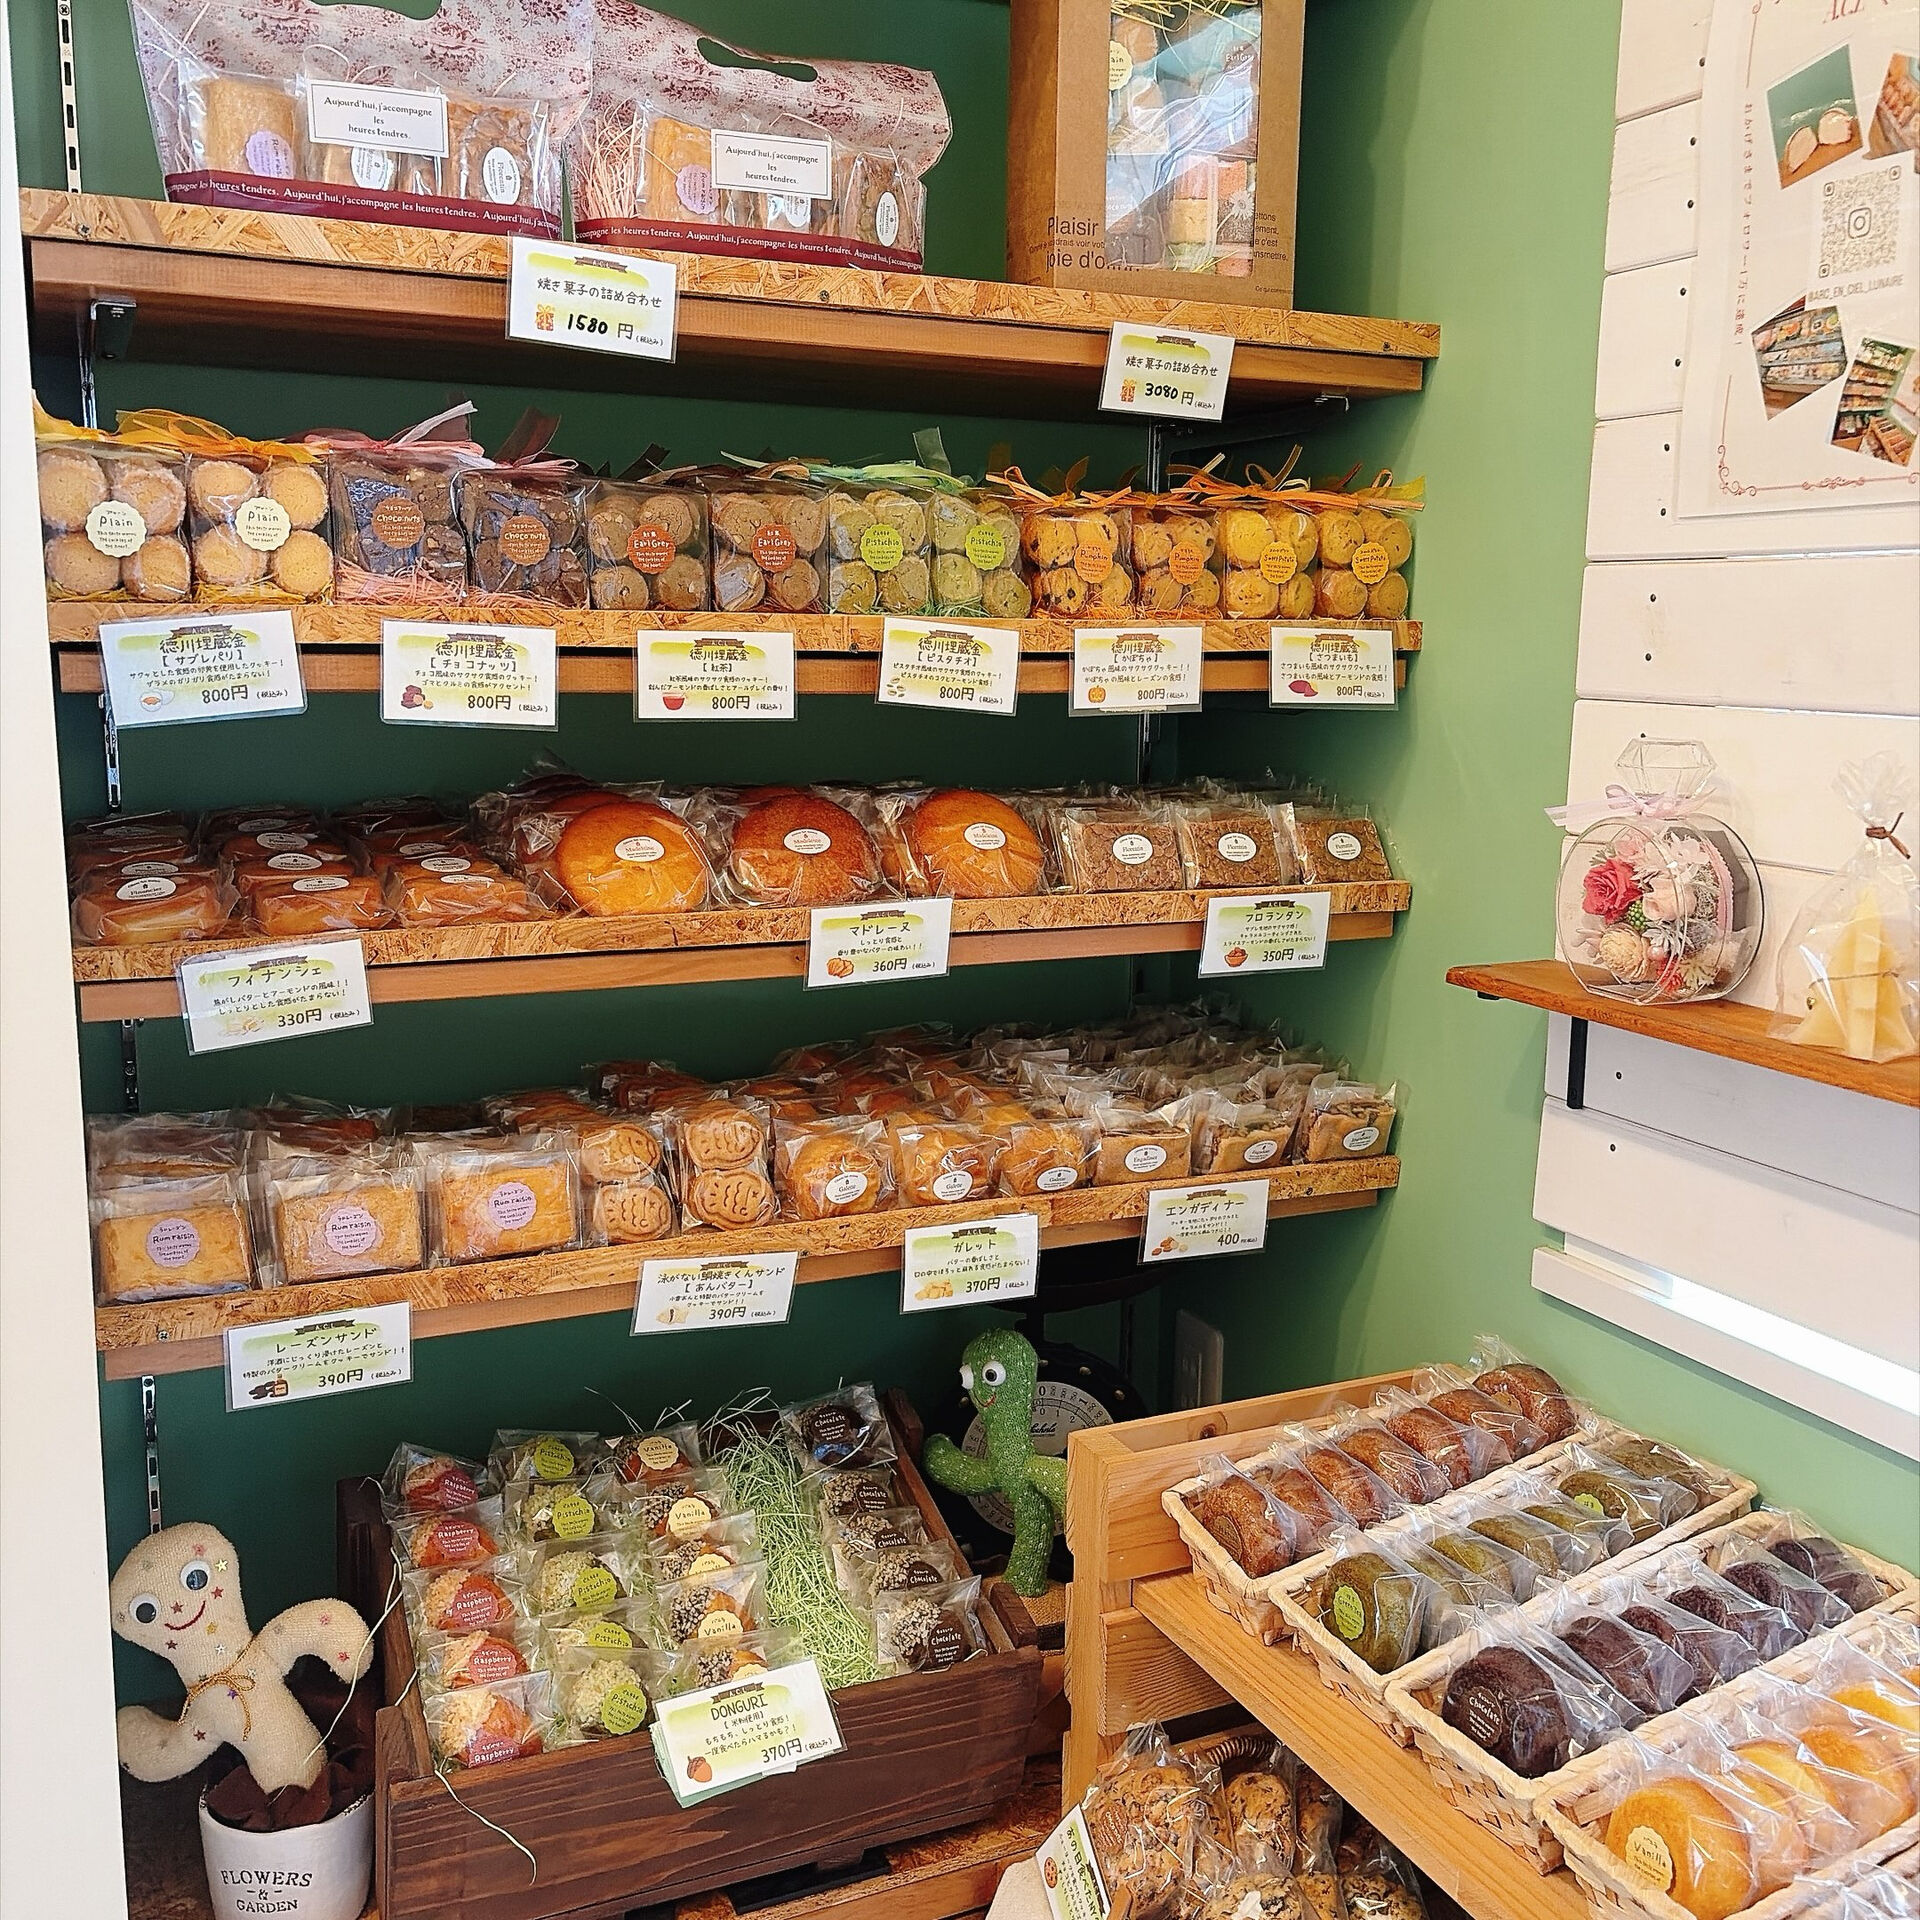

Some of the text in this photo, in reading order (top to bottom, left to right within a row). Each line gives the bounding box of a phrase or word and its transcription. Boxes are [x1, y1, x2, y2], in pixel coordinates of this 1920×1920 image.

[373, 116, 385, 125] les
[348, 124, 376, 135] heures
[767, 163, 778, 172] les
[745, 172, 769, 182] heures
[209, 179, 240, 192] heures
[402, 201, 414, 211] les
[415, 203, 444, 215] heures
[1048, 216, 1099, 237] Plaisir
[611, 227, 621, 235] les
[623, 227, 650, 238] heures
[788, 240, 799, 250] les
[799, 242, 826, 253] heures
[537, 277, 662, 308] 焼き菓子の詰め合わせ
[1125, 355, 1218, 377] 焼き菓子の詰め合わせ
[100, 515, 133, 527] Plain
[248, 510, 279, 521] Plain
[865, 538, 899, 547] Pistachio
[970, 536, 1001, 547] Pistachio
[1080, 549, 1109, 560] Pumpkin
[1174, 553, 1200, 563] Pumpkin
[160, 633, 247, 653] 徳川埋蔵金
[918, 637, 984, 657] 徳川埋蔵金
[1111, 642, 1165, 654] 徳川埋蔵金
[1310, 641, 1360, 654] 徳川埋蔵金
[436, 642, 518, 659] 徳川埋蔵金
[690, 648, 750, 662] 徳川埋蔵金
[202, 685, 248, 704] 800円
[939, 686, 975, 701] 800円
[1137, 688, 1165, 700] 800円
[1336, 685, 1363, 697] 800円
[468, 695, 511, 710] 800円
[711, 695, 750, 710] 800円
[1246, 911, 1304, 922] フロランタン
[850, 921, 911, 937] マドレーヌ
[1262, 948, 1294, 963] 350円
[873, 958, 907, 972] 360円
[228, 965, 322, 988] フィナンシェ
[278, 1008, 322, 1028] 330円
[1166, 1200, 1244, 1216] エンガディナー
[954, 1239, 996, 1253] ガレット
[658, 1267, 785, 1285] 泳がない鯛焼きくんサンド
[966, 1277, 1000, 1293] 370円
[709, 1306, 746, 1320] 390円
[276, 1328, 377, 1353] レーズンサンド
[318, 1369, 363, 1388] 390円
[814, 1415, 846, 1428] Chocolate
[540, 1448, 572, 1463] Pistachio
[643, 1444, 673, 1453] Vanilla
[444, 1479, 476, 1495] Raspberry
[859, 1490, 887, 1499] Chocolate
[557, 1508, 590, 1518] Pistachio
[675, 1509, 705, 1520] Vanilla
[438, 1527, 474, 1539] Raspberry
[877, 1537, 907, 1548] Chocolate
[578, 1577, 612, 1596] Pistachio
[909, 1575, 938, 1584] Chocolate
[456, 1596, 493, 1611] Raspberry
[704, 1622, 736, 1636] Vanilla
[594, 1633, 629, 1647] Pistachio
[931, 1633, 962, 1645] Chocolate
[473, 1655, 512, 1666] Raspberry
[611, 1693, 644, 1714] Pistachio
[711, 1694, 768, 1721] DONGURI
[1470, 1697, 1499, 1725] Chocolate
[474, 1746, 515, 1764] Raspberry
[761, 1737, 802, 1764] 370円
[1634, 1841, 1666, 1868] Vanilla
[221, 1870, 313, 1887] FLOWERS
[237, 1900, 298, 1913] GARDEN
